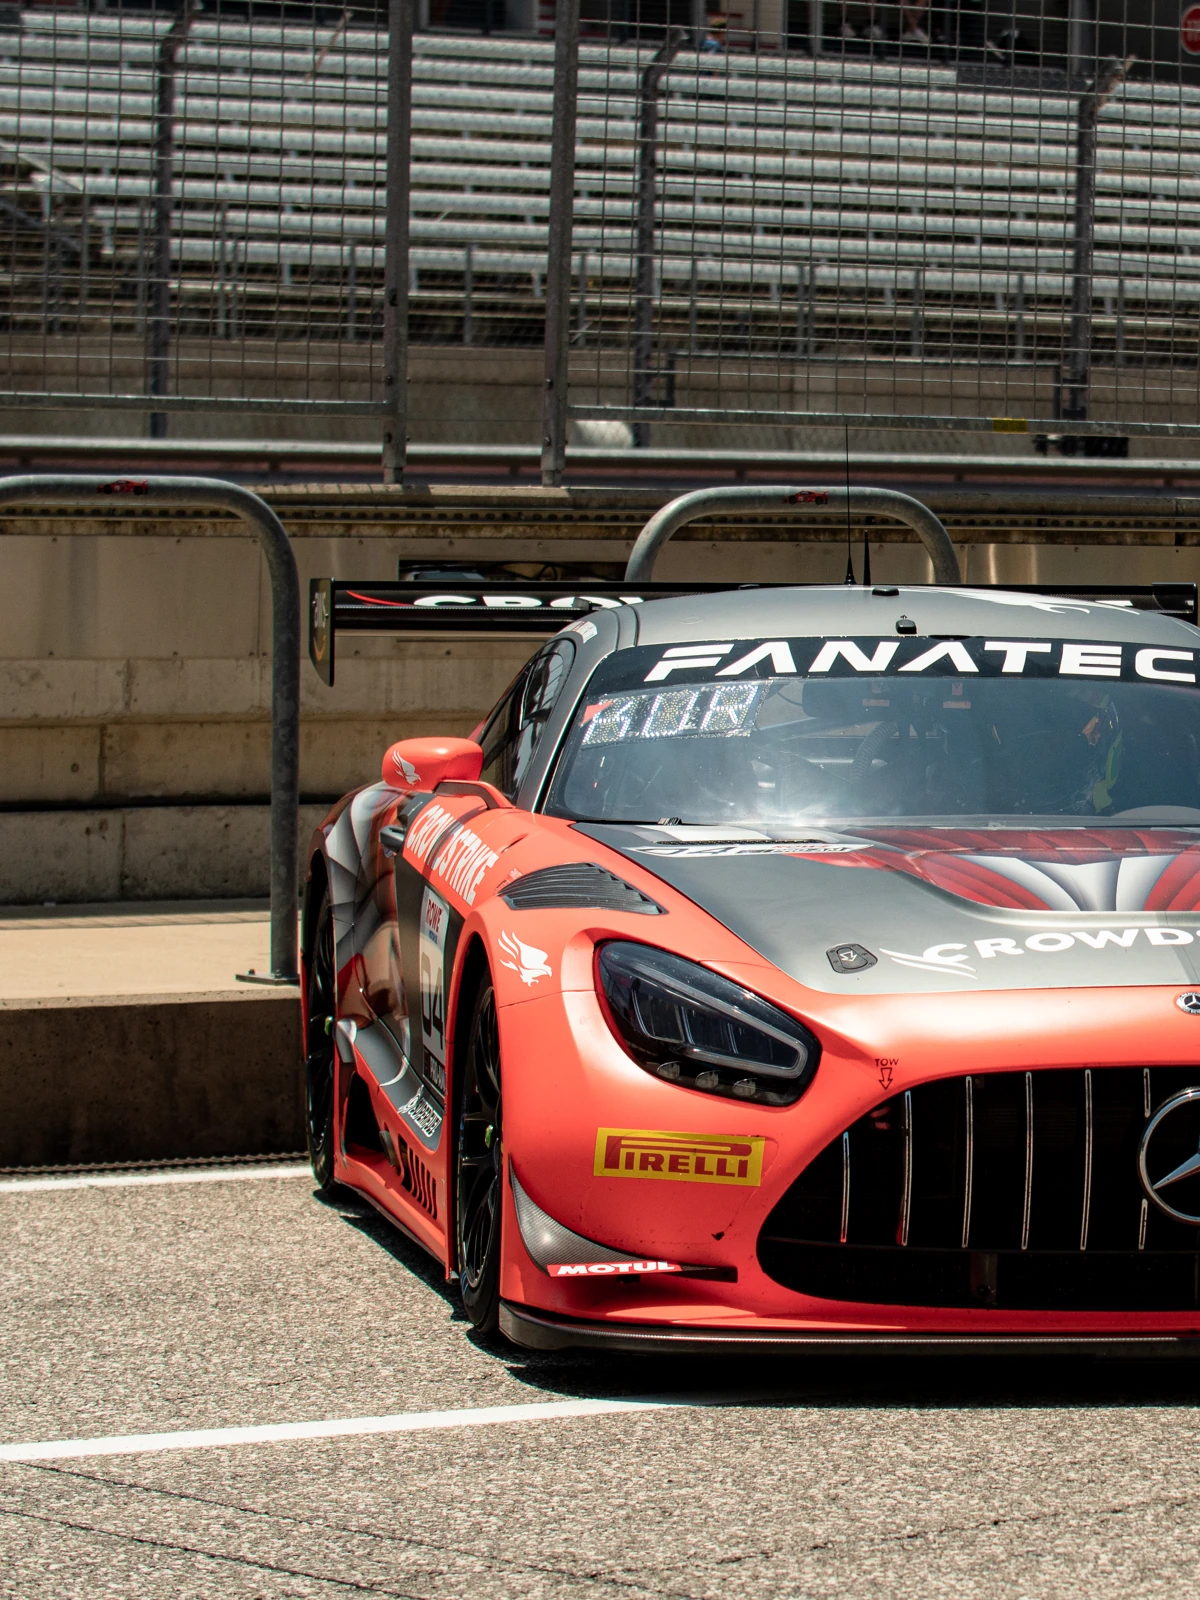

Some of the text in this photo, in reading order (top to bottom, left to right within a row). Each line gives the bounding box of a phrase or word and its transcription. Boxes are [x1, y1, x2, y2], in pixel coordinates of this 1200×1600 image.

[643, 641, 1196, 682] FANATEC
[420, 952, 443, 1050] 04
[875, 1058, 899, 1067] TOW
[604, 1135, 752, 1178] PIRELLI
[557, 1261, 675, 1275] MOTUL
